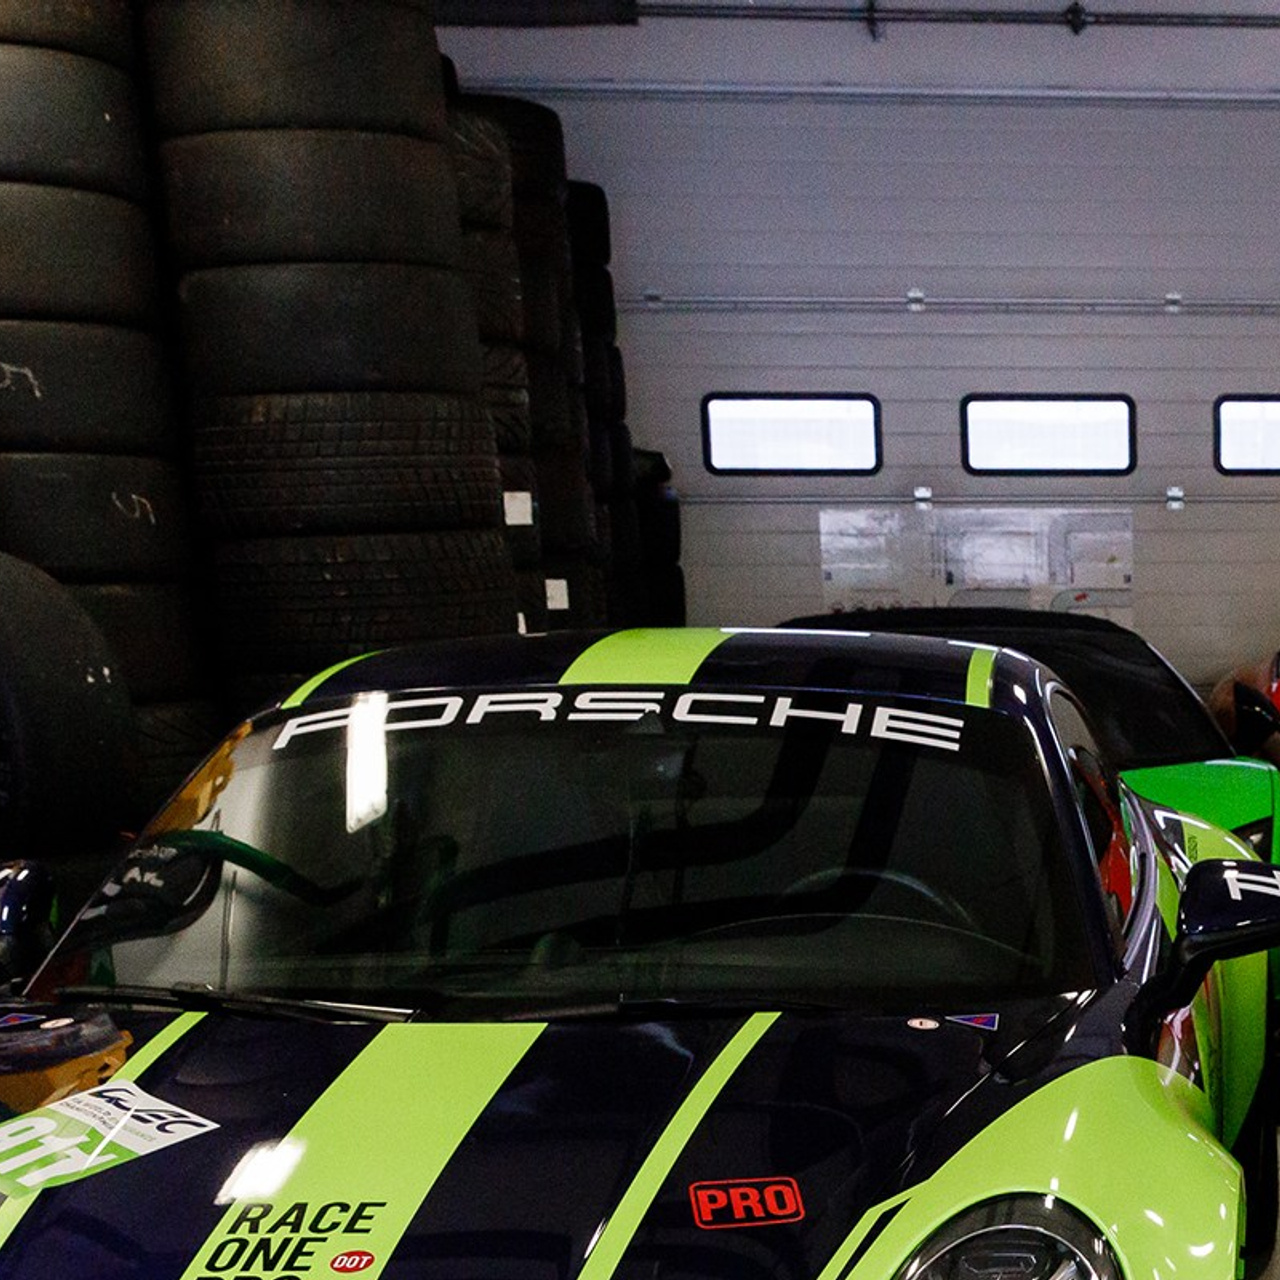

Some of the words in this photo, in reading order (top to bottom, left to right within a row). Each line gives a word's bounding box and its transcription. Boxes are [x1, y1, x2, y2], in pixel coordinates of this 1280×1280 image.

[272, 690, 965, 751] PORSCHE
[226, 1202, 387, 1235] RACE
[696, 1184, 797, 1221] PRO
[205, 1237, 328, 1272] ONE
[333, 1255, 372, 1269] DOT
